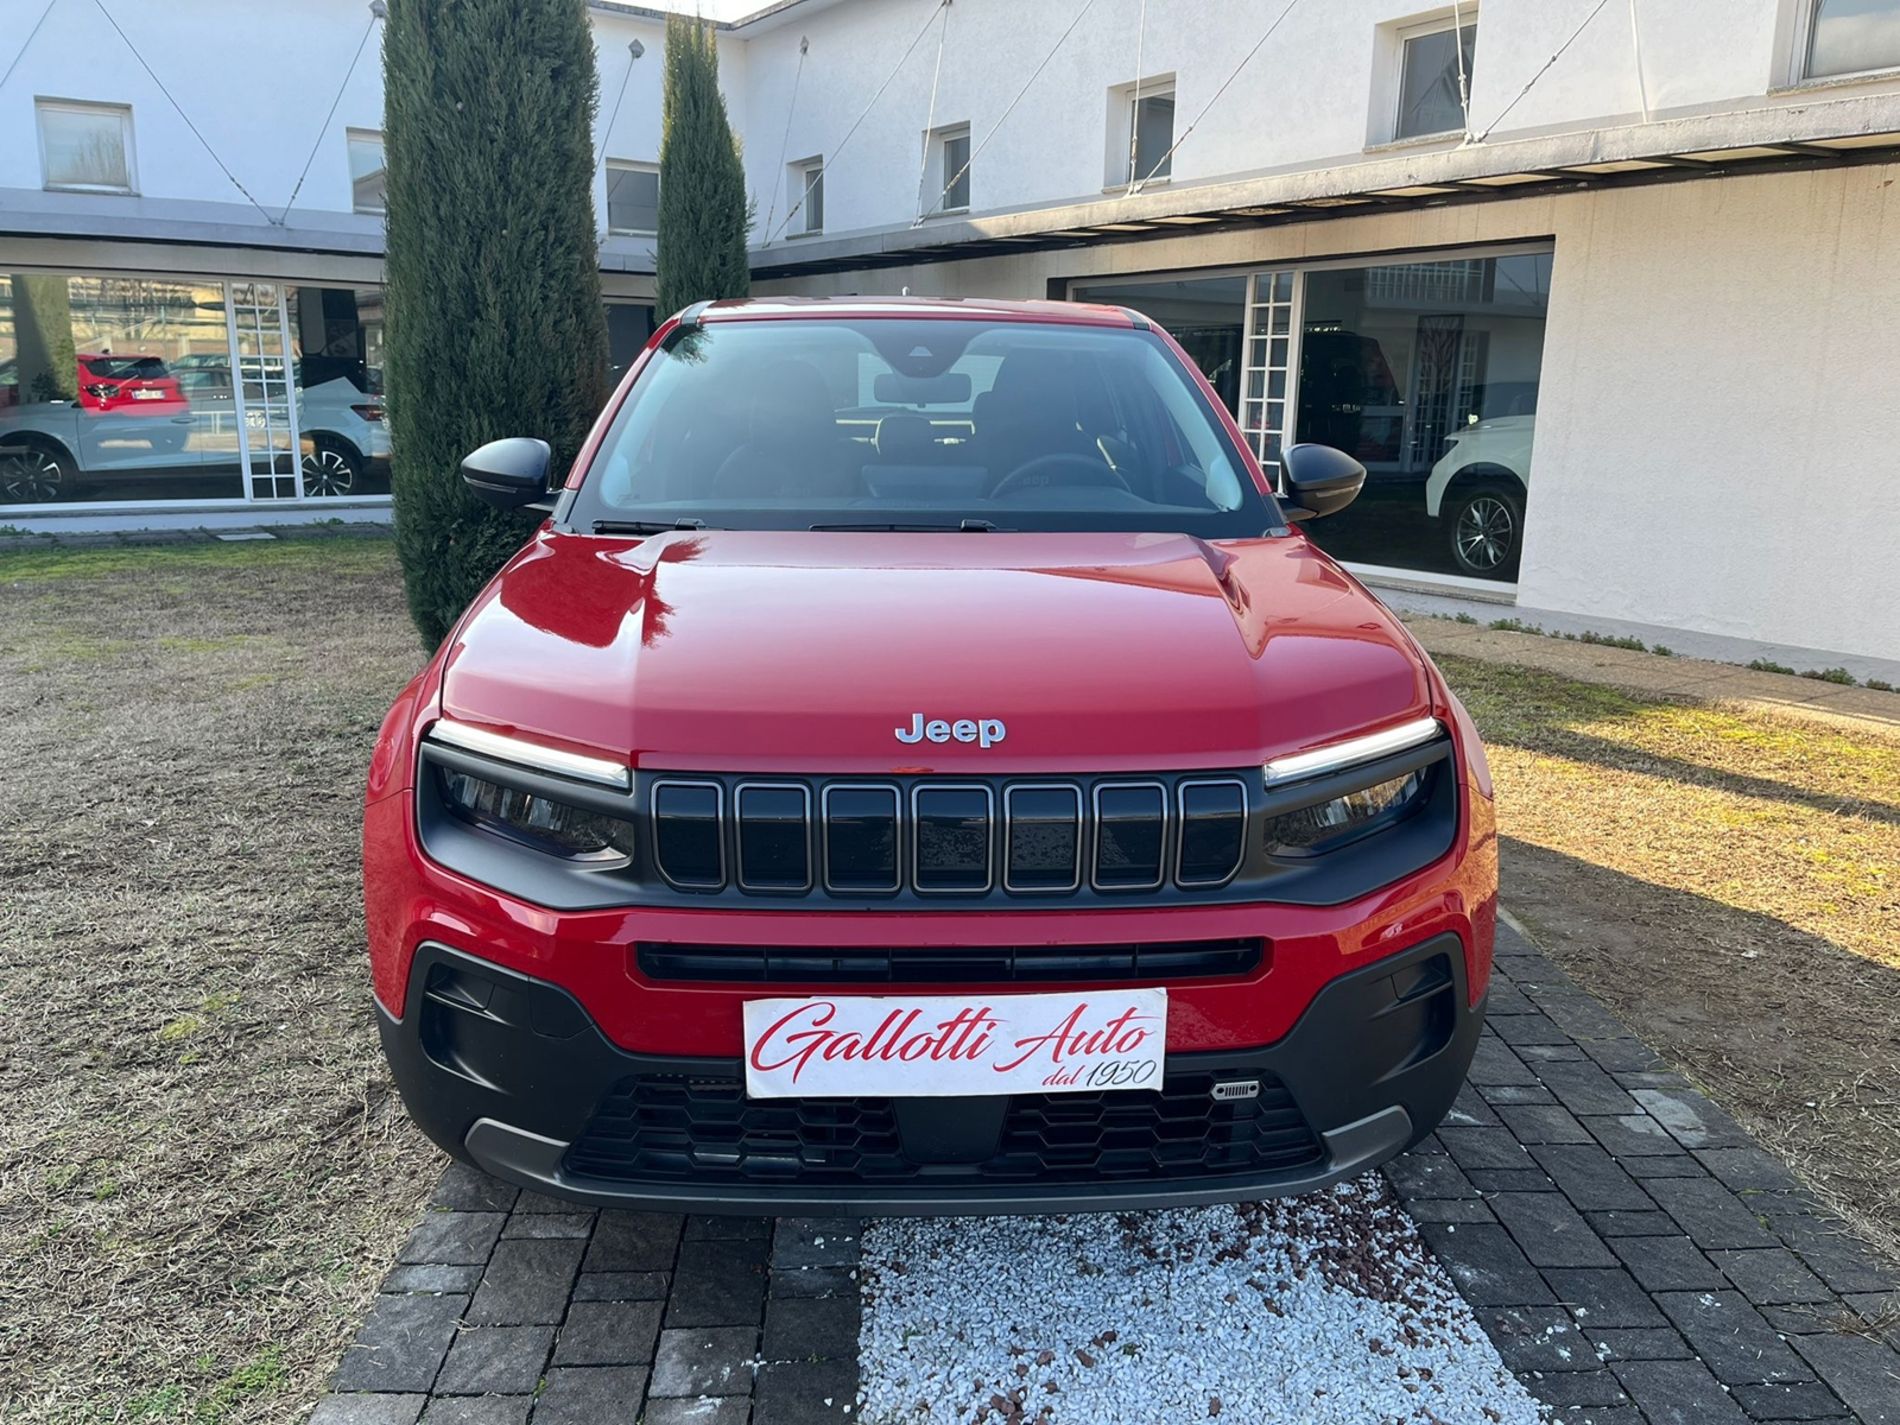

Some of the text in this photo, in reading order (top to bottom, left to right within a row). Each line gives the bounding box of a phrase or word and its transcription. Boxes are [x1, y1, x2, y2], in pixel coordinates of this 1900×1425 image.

[895, 713, 1006, 748] Jeep
[750, 1001, 1161, 1084] Gallotti Auto
[1042, 1059, 1157, 1087] dal 1950
